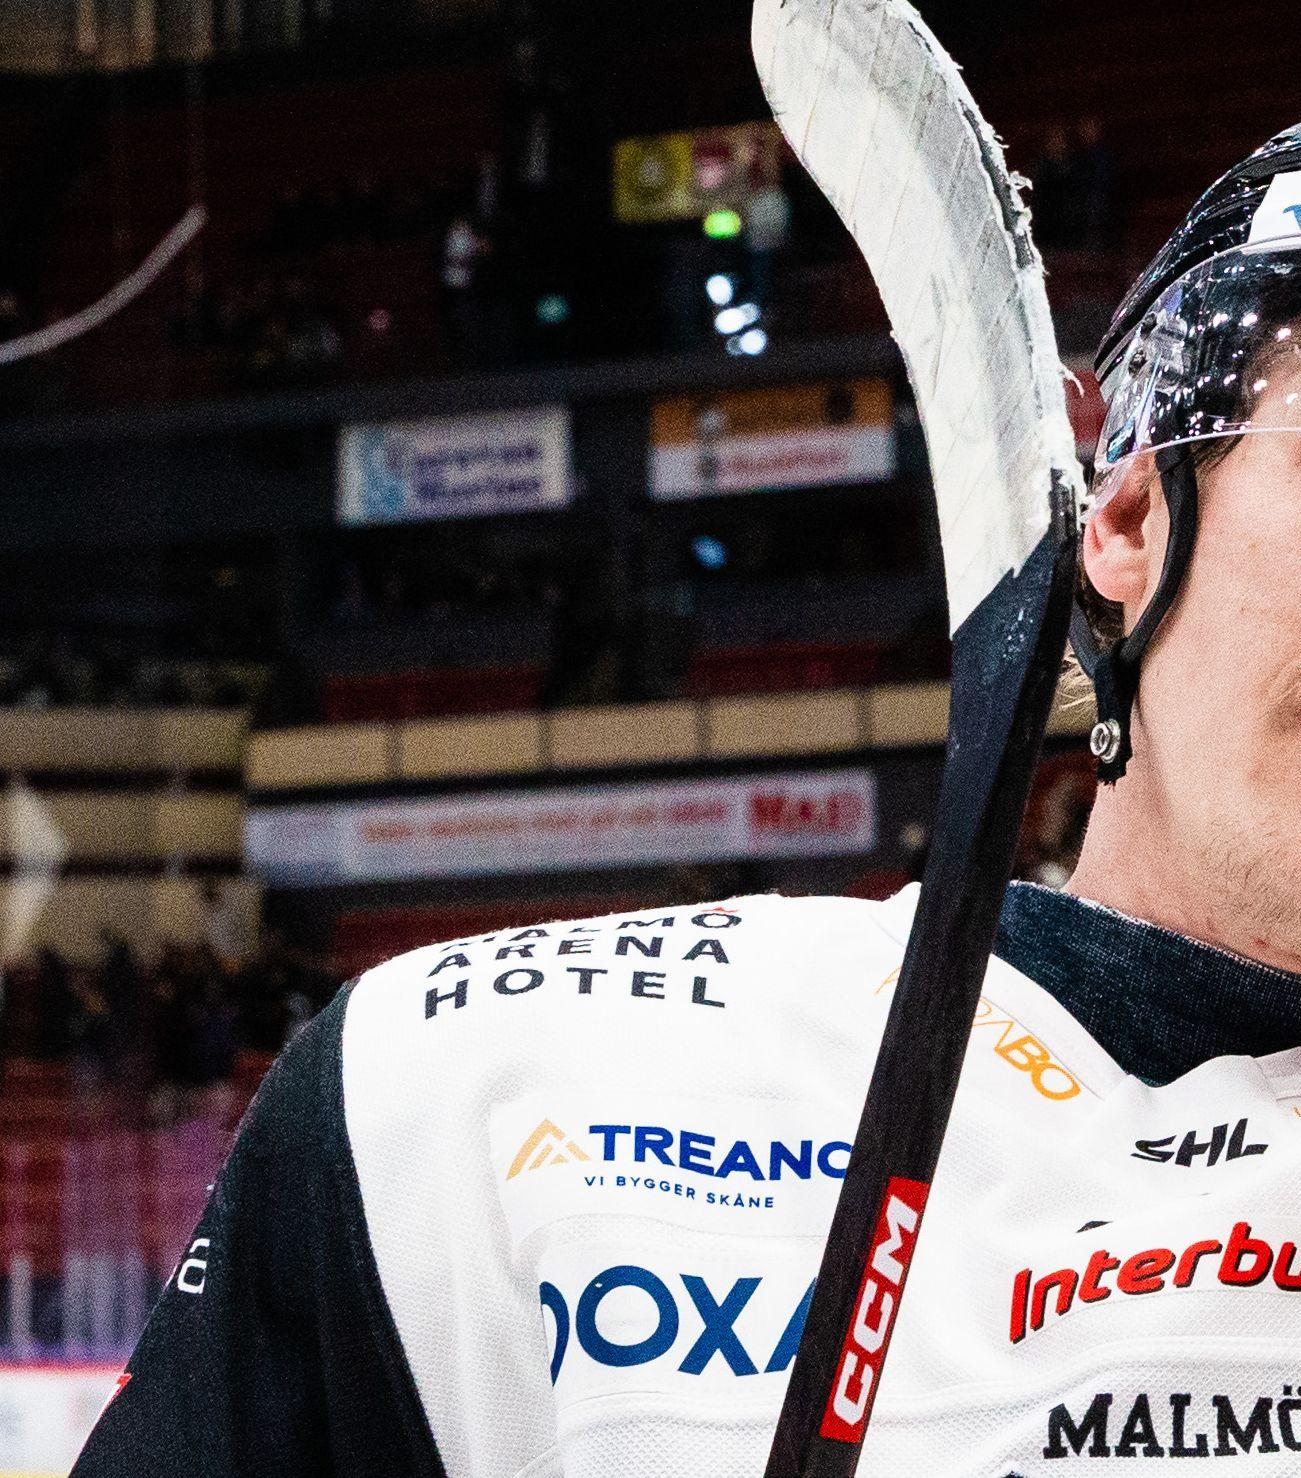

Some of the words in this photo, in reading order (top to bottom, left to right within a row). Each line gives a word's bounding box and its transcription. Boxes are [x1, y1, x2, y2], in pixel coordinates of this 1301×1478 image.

[427, 936, 730, 977] ARENA
[425, 967, 726, 1019] HOTEL
[1131, 1118, 1269, 1167] SHL
[584, 1176, 605, 1187] VI
[616, 1176, 696, 1200] BYGGER
[706, 1193, 775, 1208] SKÅNE
[833, 1195, 918, 1425] CCM
